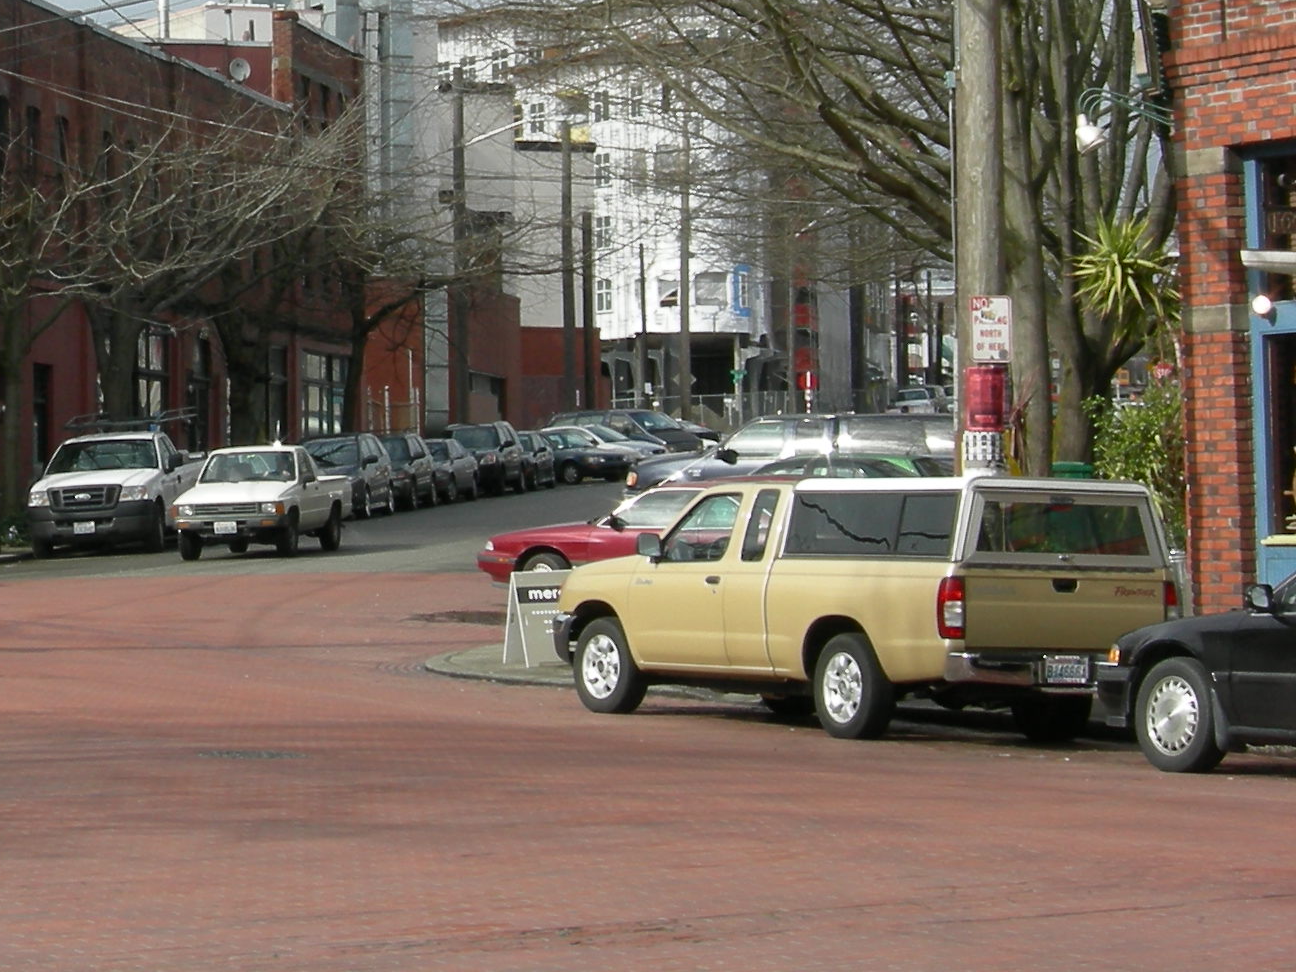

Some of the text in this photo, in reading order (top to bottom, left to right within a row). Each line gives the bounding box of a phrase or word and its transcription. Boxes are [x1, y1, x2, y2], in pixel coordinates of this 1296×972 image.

[972, 297, 988, 310] NO
[979, 329, 1002, 338] NORTH
[975, 341, 1005, 351] OF HERE
